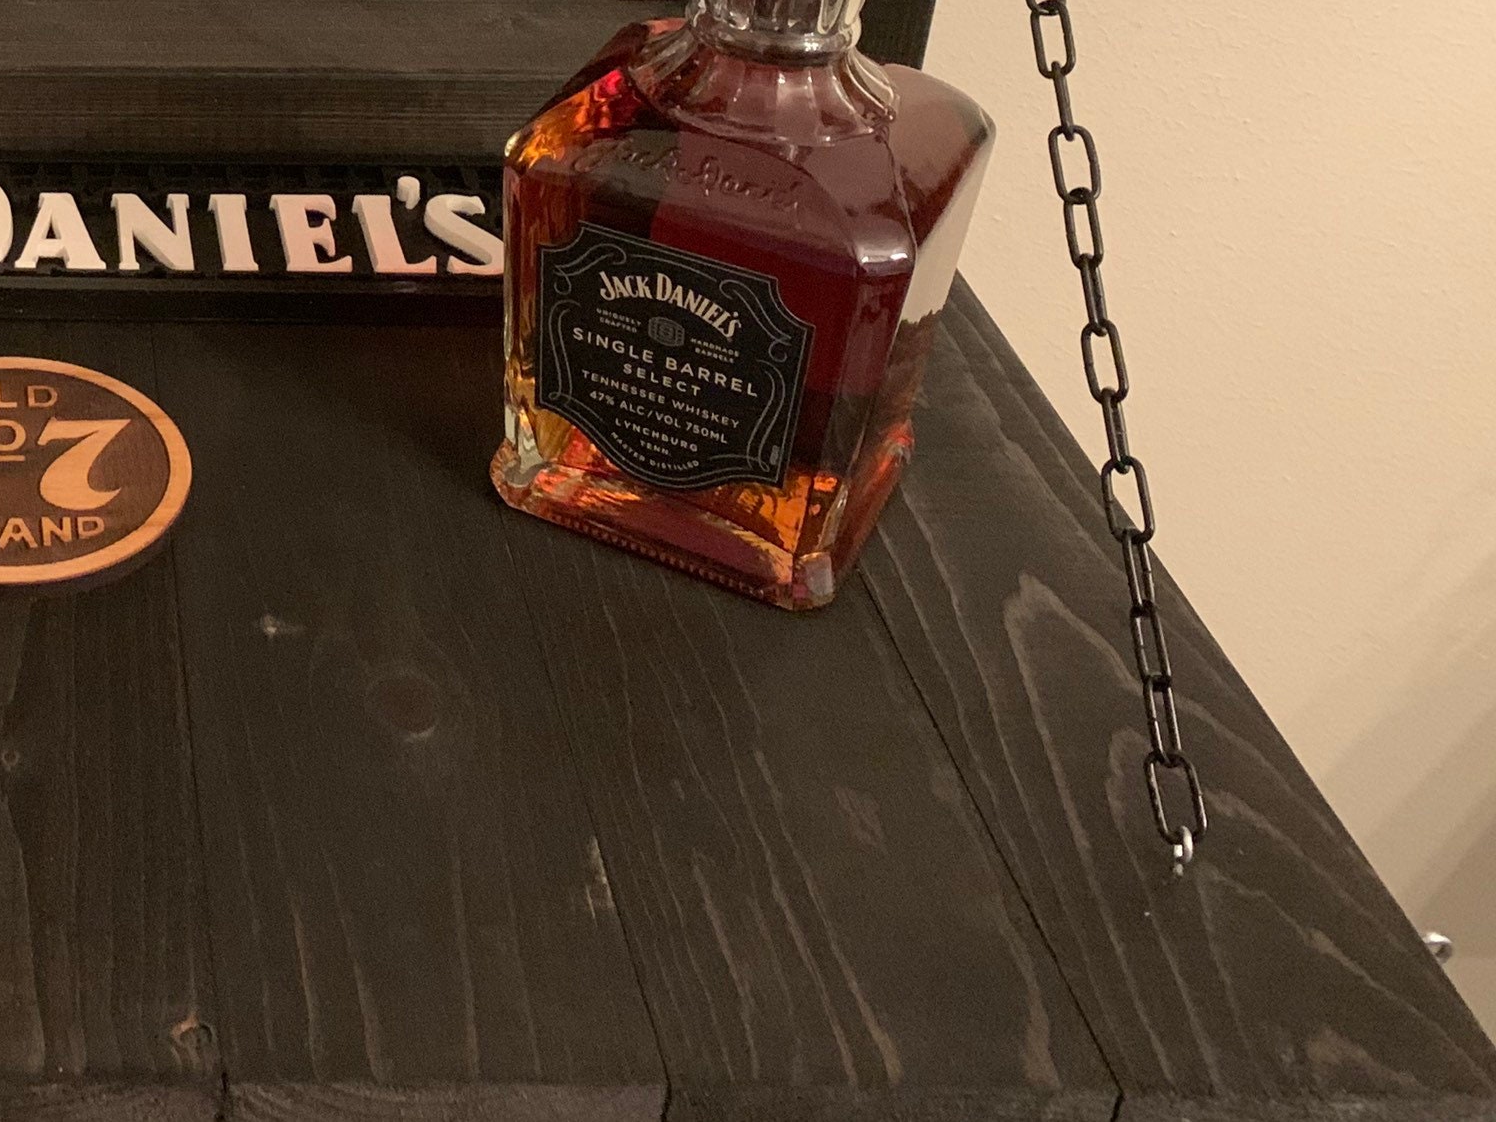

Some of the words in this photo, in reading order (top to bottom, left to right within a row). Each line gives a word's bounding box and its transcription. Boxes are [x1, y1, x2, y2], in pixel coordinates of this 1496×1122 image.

[596, 308, 642, 327] UNIQUELY
[599, 271, 653, 301] JACK
[656, 272, 742, 338] DANIEL'S
[572, 327, 655, 364] SINGLE
[665, 356, 758, 397] BARREL
[690, 337, 740, 358] HANDMADE
[581, 369, 665, 404] TENNESSEE
[672, 399, 740, 428] WHISKEY
[623, 363, 701, 396] SELECT
[590, 391, 614, 406] 47%
[686, 421, 728, 444] 750ML
[615, 418, 698, 452] LYNCHBURG
[611, 431, 646, 462] MASTER
[650, 459, 699, 471] DISTILLED
